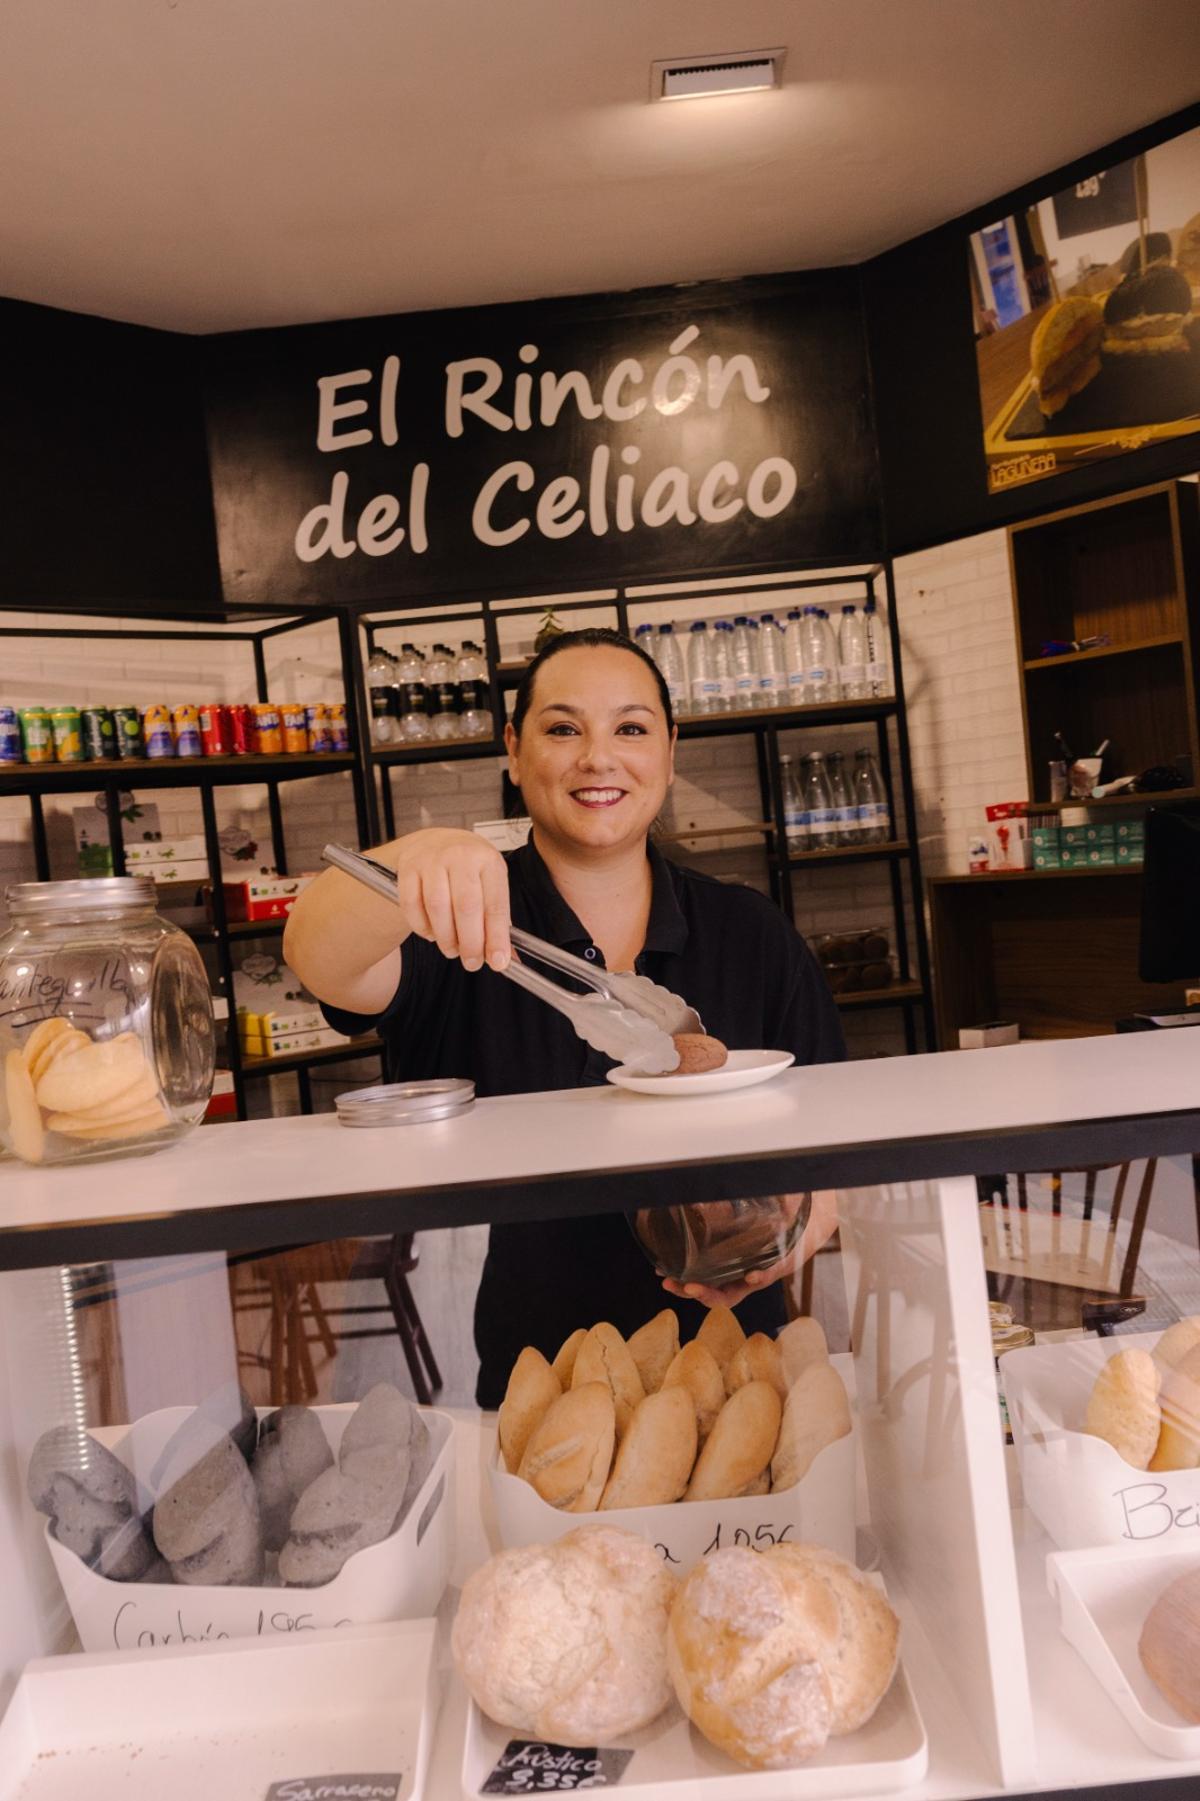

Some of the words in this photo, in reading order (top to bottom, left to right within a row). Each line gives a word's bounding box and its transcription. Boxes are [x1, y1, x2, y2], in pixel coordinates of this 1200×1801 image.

[317, 355, 400, 452] El
[446, 325, 770, 438] Rincón
[295, 463, 429, 562] del
[472, 444, 797, 546] Celiaco
